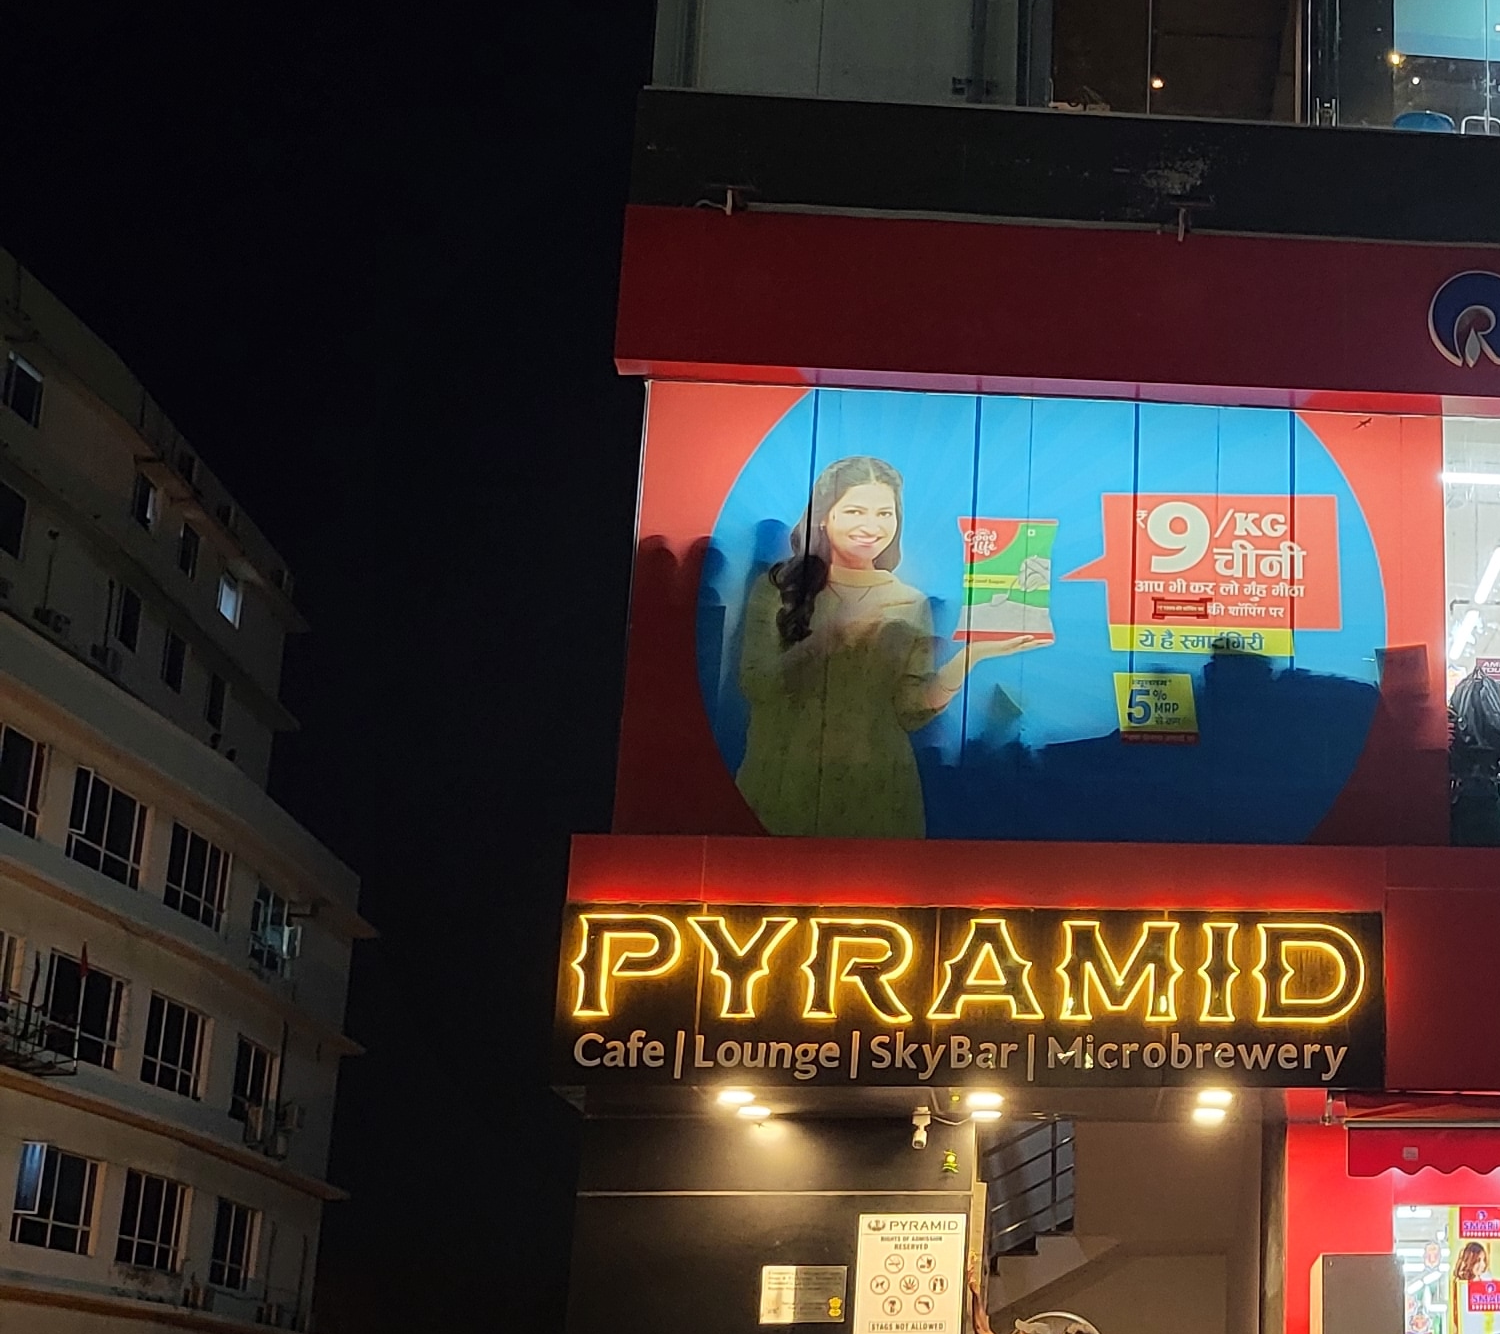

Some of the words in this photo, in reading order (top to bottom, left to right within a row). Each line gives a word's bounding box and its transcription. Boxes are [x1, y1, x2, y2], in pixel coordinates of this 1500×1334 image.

[1213, 540, 1306, 580] चीनी
[1134, 580, 1165, 596] आप
[1168, 579, 1187, 595] भी
[1189, 581, 1216, 597] कर
[1219, 578, 1240, 597] लो
[1269, 605, 1285, 617] पर
[1139, 632, 1156, 651] ये
[1160, 630, 1174, 651] है
[1181, 629, 1265, 652] स्मार्टगिरी
[1127, 688, 1151, 725] 5
[1154, 702, 1179, 714] MRP
[572, 913, 1366, 1024] PYRAMID
[573, 1029, 667, 1068] Cafe
[694, 1032, 841, 1077] Lounge
[870, 1034, 1019, 1078] SkyBar
[1047, 1036, 1349, 1077] Microbrewery
[889, 1220, 959, 1231] PYRAMID
[871, 1322, 894, 1331] STAGS
[895, 1322, 910, 1331] NOT
[911, 1322, 944, 1331] ALLOWED
